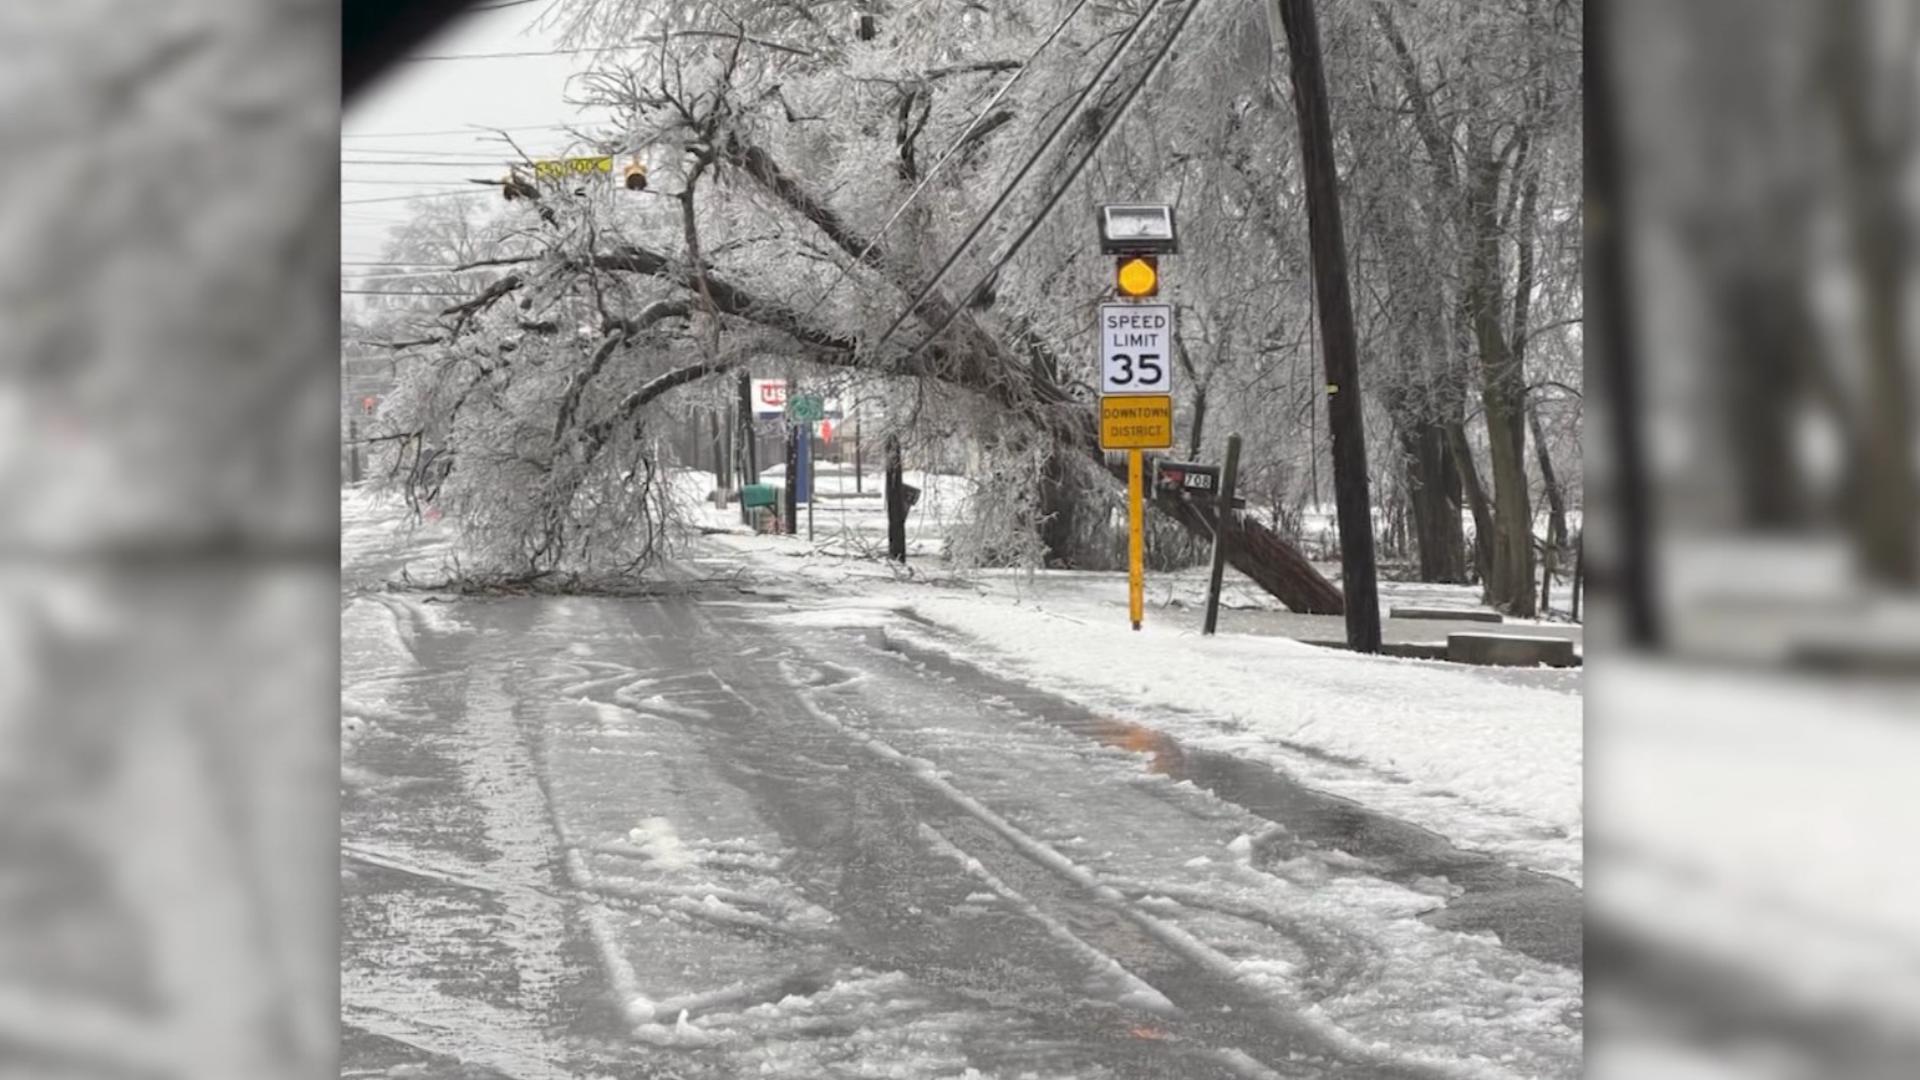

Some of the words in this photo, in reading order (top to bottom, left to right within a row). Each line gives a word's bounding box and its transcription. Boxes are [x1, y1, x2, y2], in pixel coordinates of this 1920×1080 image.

[1107, 315, 1166, 329] SPEED
[1113, 333, 1159, 347] LIMIT
[1110, 353, 1162, 385] 35
[1103, 408, 1168, 419] DOWNTOWN
[1111, 425, 1162, 437] DISTRICT
